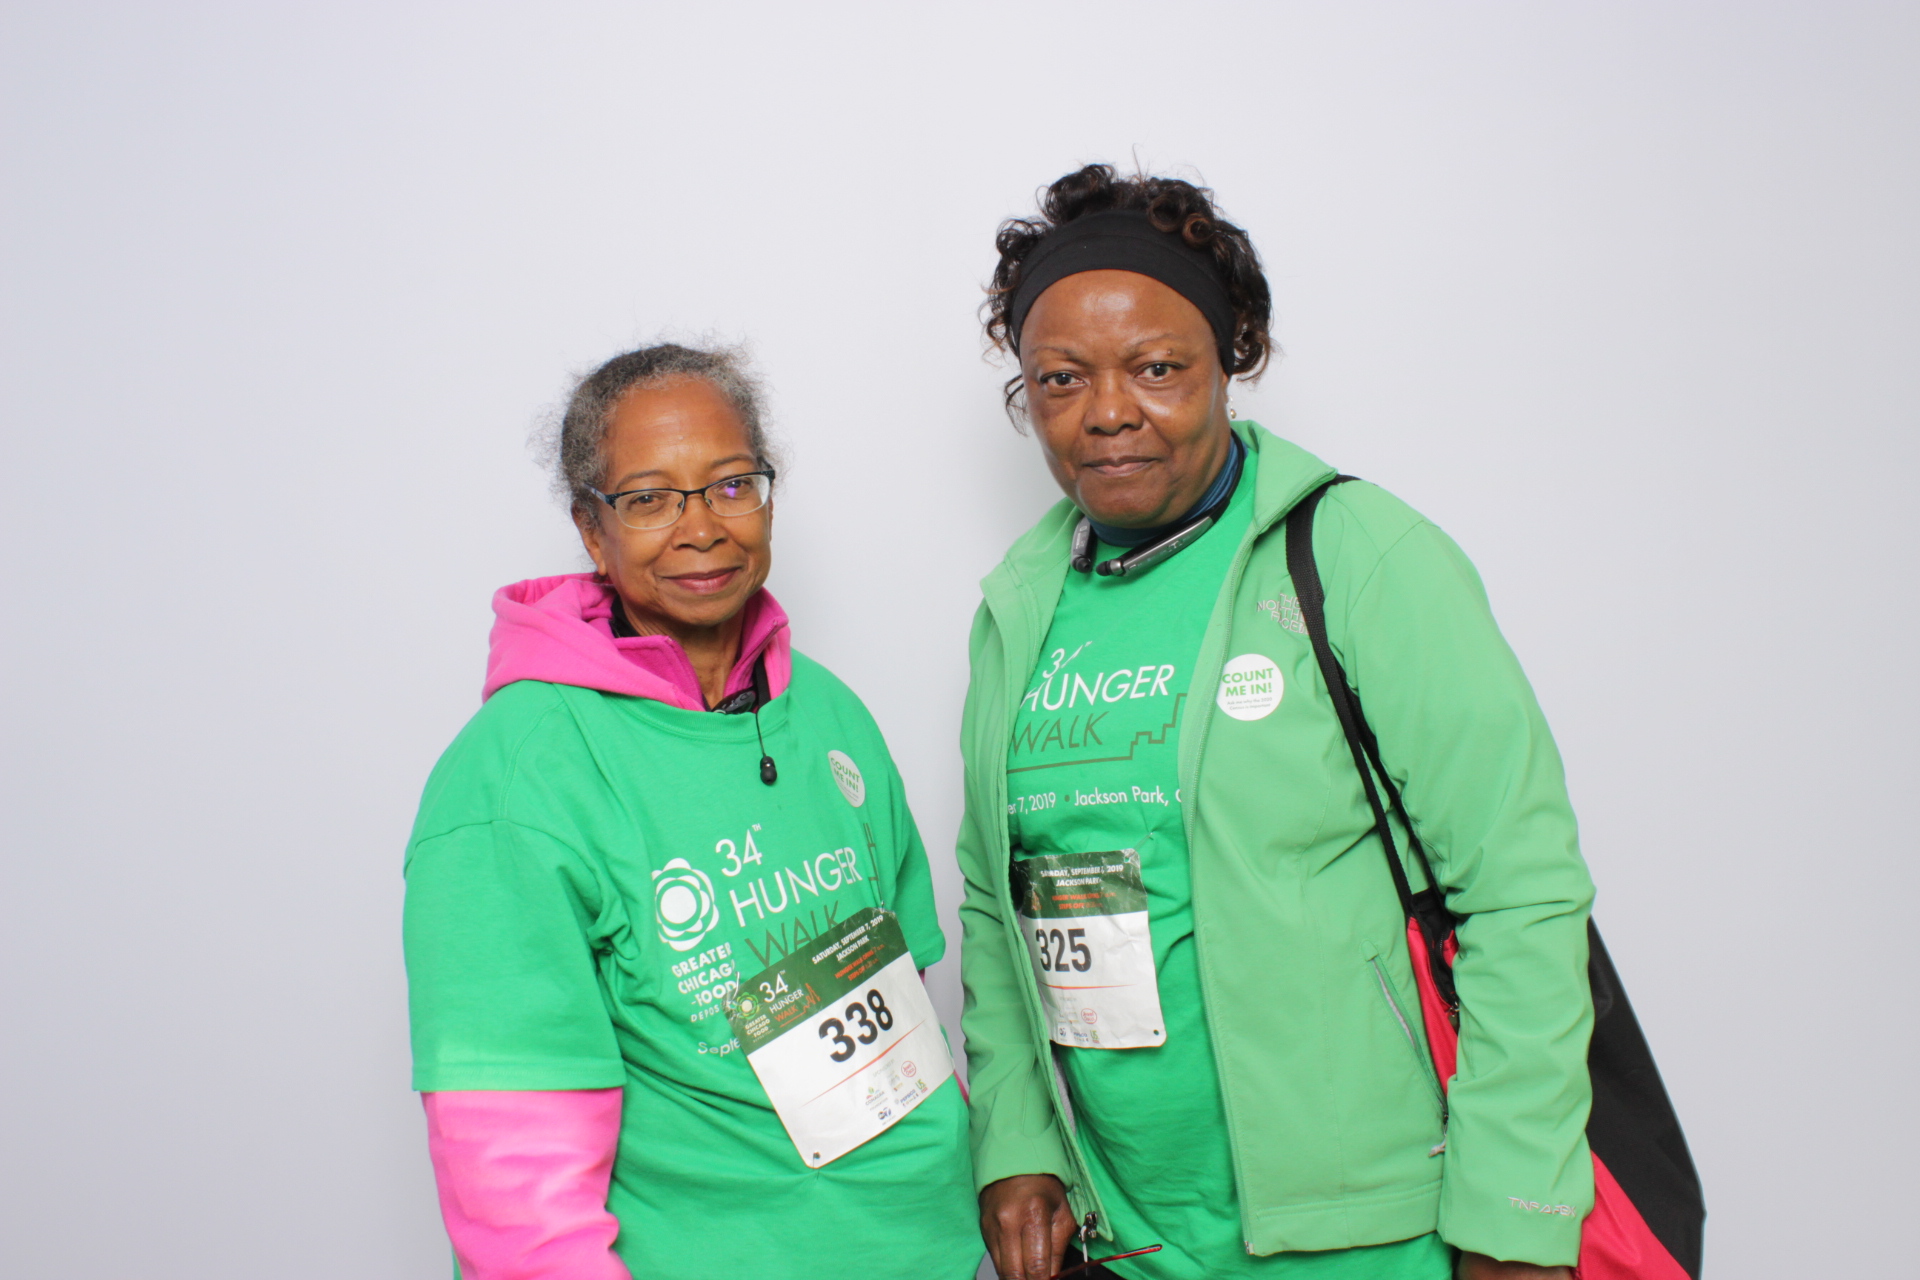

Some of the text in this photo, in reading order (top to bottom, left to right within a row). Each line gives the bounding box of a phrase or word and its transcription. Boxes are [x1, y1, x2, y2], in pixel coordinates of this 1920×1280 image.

[1222, 668, 1273, 684] COUNT
[1020, 664, 1175, 711] HUNGER
[1226, 682, 1272, 697] ME IN!
[1012, 711, 1109, 757] WALK
[831, 757, 860, 783] COUNT
[846, 777, 859, 793] IN!
[1017, 797, 1028, 814] 7,
[1029, 792, 1056, 811] 2019
[1075, 787, 1128, 806] Jackson
[1132, 786, 1169, 806] Park,
[1106, 864, 1124, 873] 2019
[729, 847, 863, 927] HUNGER
[1056, 877, 1085, 887] JACKSON
[812, 941, 842, 965] SATURDAY,
[870, 914, 884, 927] 2019
[671, 942, 732, 978] GREATER
[836, 942, 859, 961] JACKSON
[1035, 928, 1092, 973] 325
[769, 988, 804, 1014] HUNGER
[690, 1003, 720, 1023] DEPOS
[745, 1014, 767, 1030] GREATER
[774, 1004, 799, 1022] WALK
[746, 1018, 771, 1035] CHICAGO
[753, 1026, 769, 1038] FOOD
[818, 988, 893, 1063] 338
[697, 1037, 741, 1058] Septe
[1507, 1196, 1540, 1211] TNF
